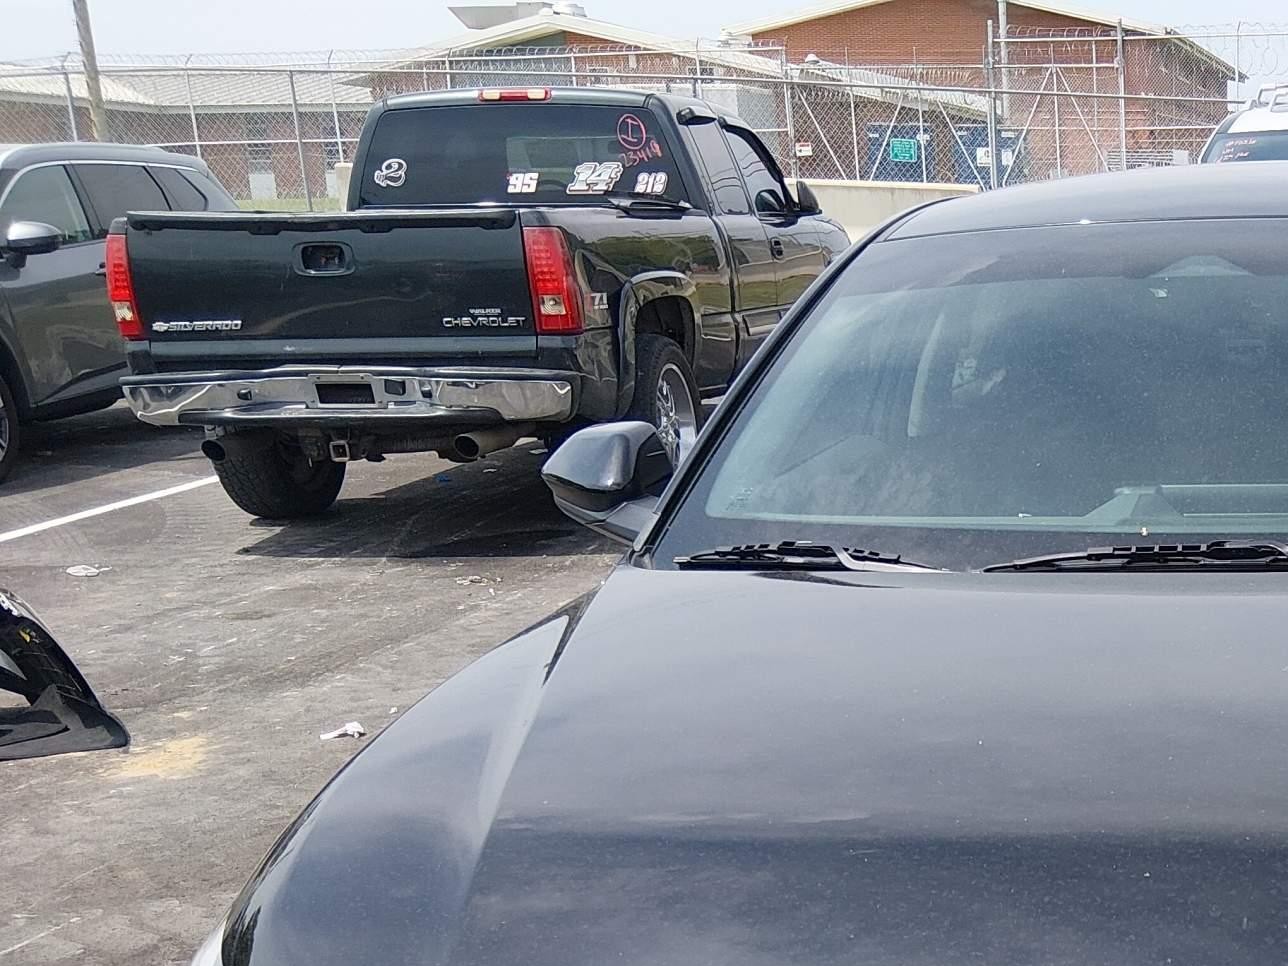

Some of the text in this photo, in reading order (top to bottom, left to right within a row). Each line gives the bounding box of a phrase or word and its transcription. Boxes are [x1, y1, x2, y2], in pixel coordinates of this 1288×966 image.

[507, 172, 539, 194] 95
[167, 320, 242, 331] SILVERADO
[442, 316, 526, 327] CHEVROLET
